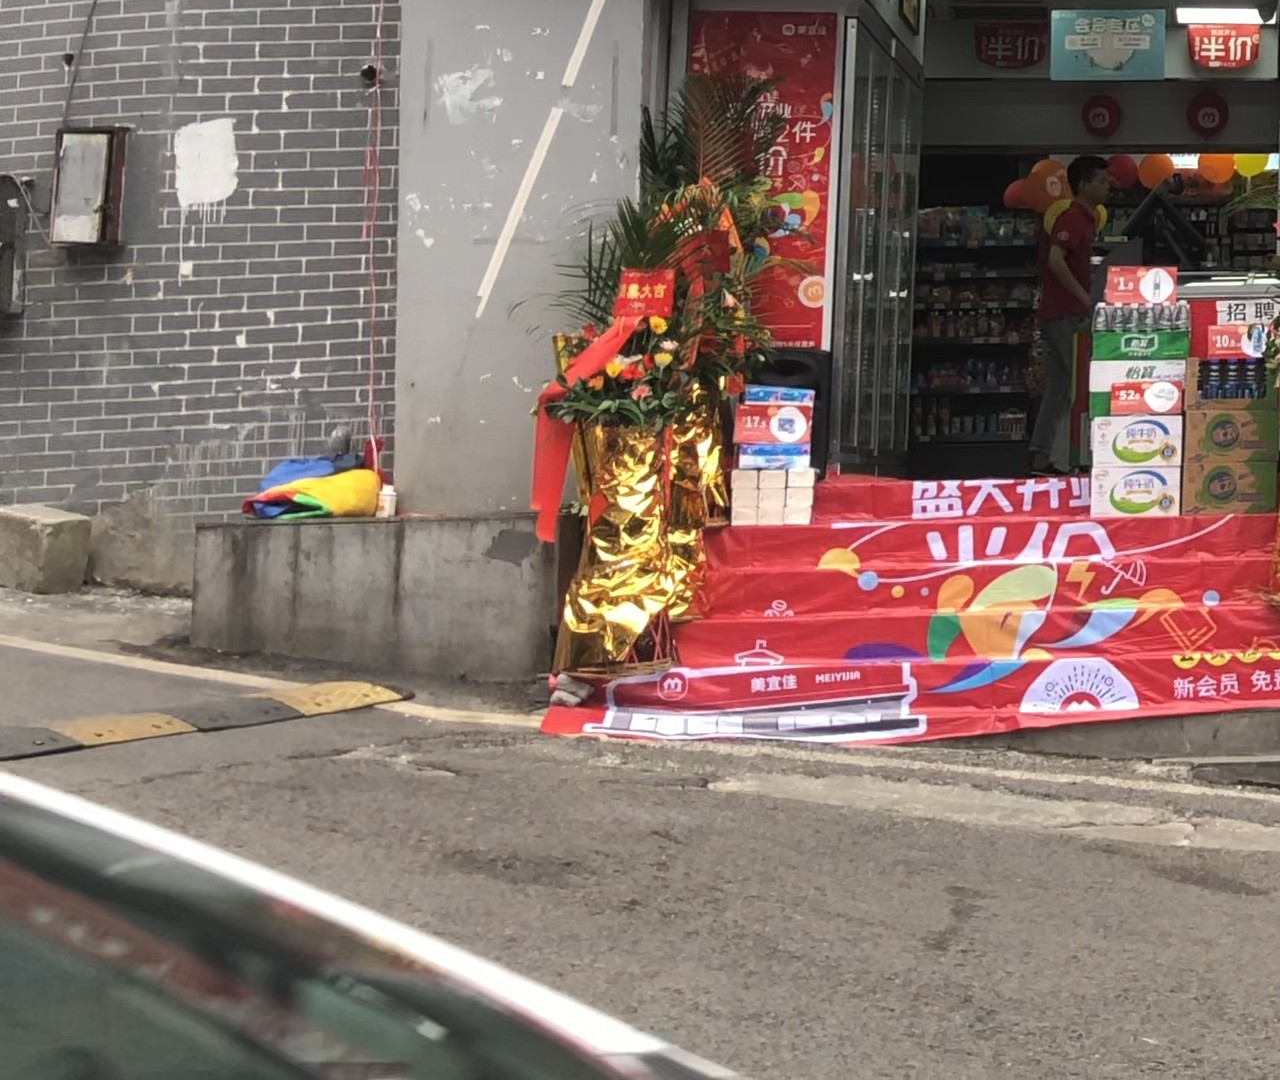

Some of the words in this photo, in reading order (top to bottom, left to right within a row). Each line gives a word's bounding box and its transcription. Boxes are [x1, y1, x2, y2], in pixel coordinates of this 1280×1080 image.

[1227, 303, 1275, 322] 招聘
[751, 674, 797, 693] 美宜佳
[1173, 674, 1240, 699] 新会员
